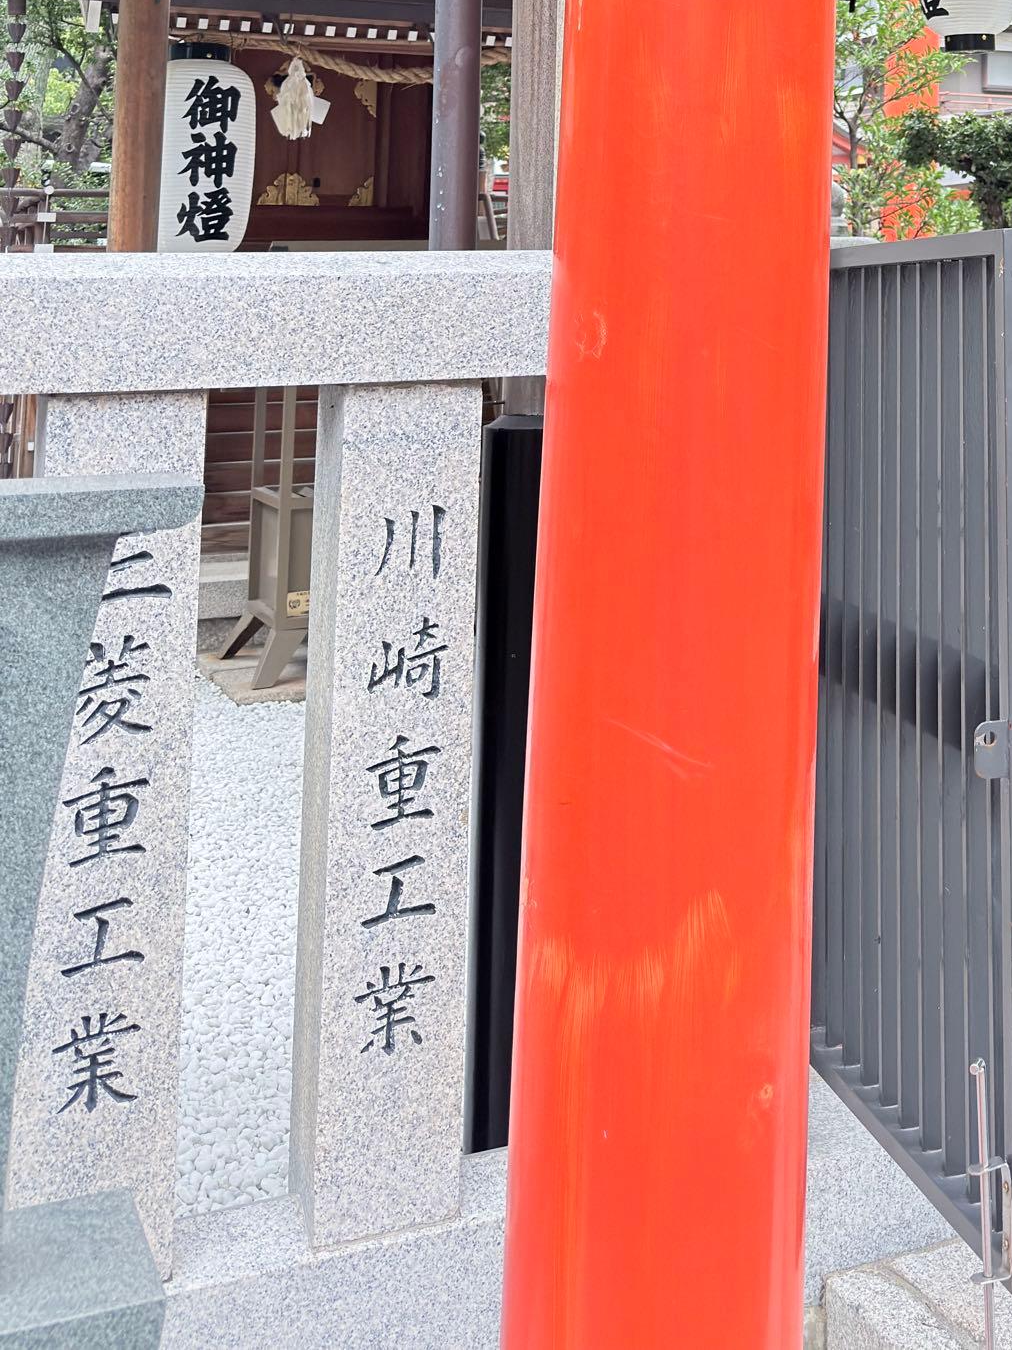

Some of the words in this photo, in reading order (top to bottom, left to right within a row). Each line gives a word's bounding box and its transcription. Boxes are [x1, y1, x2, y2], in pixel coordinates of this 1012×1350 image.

[176, 75, 241, 242] 御神燈
[354, 505, 448, 1055] 川崎重工業
